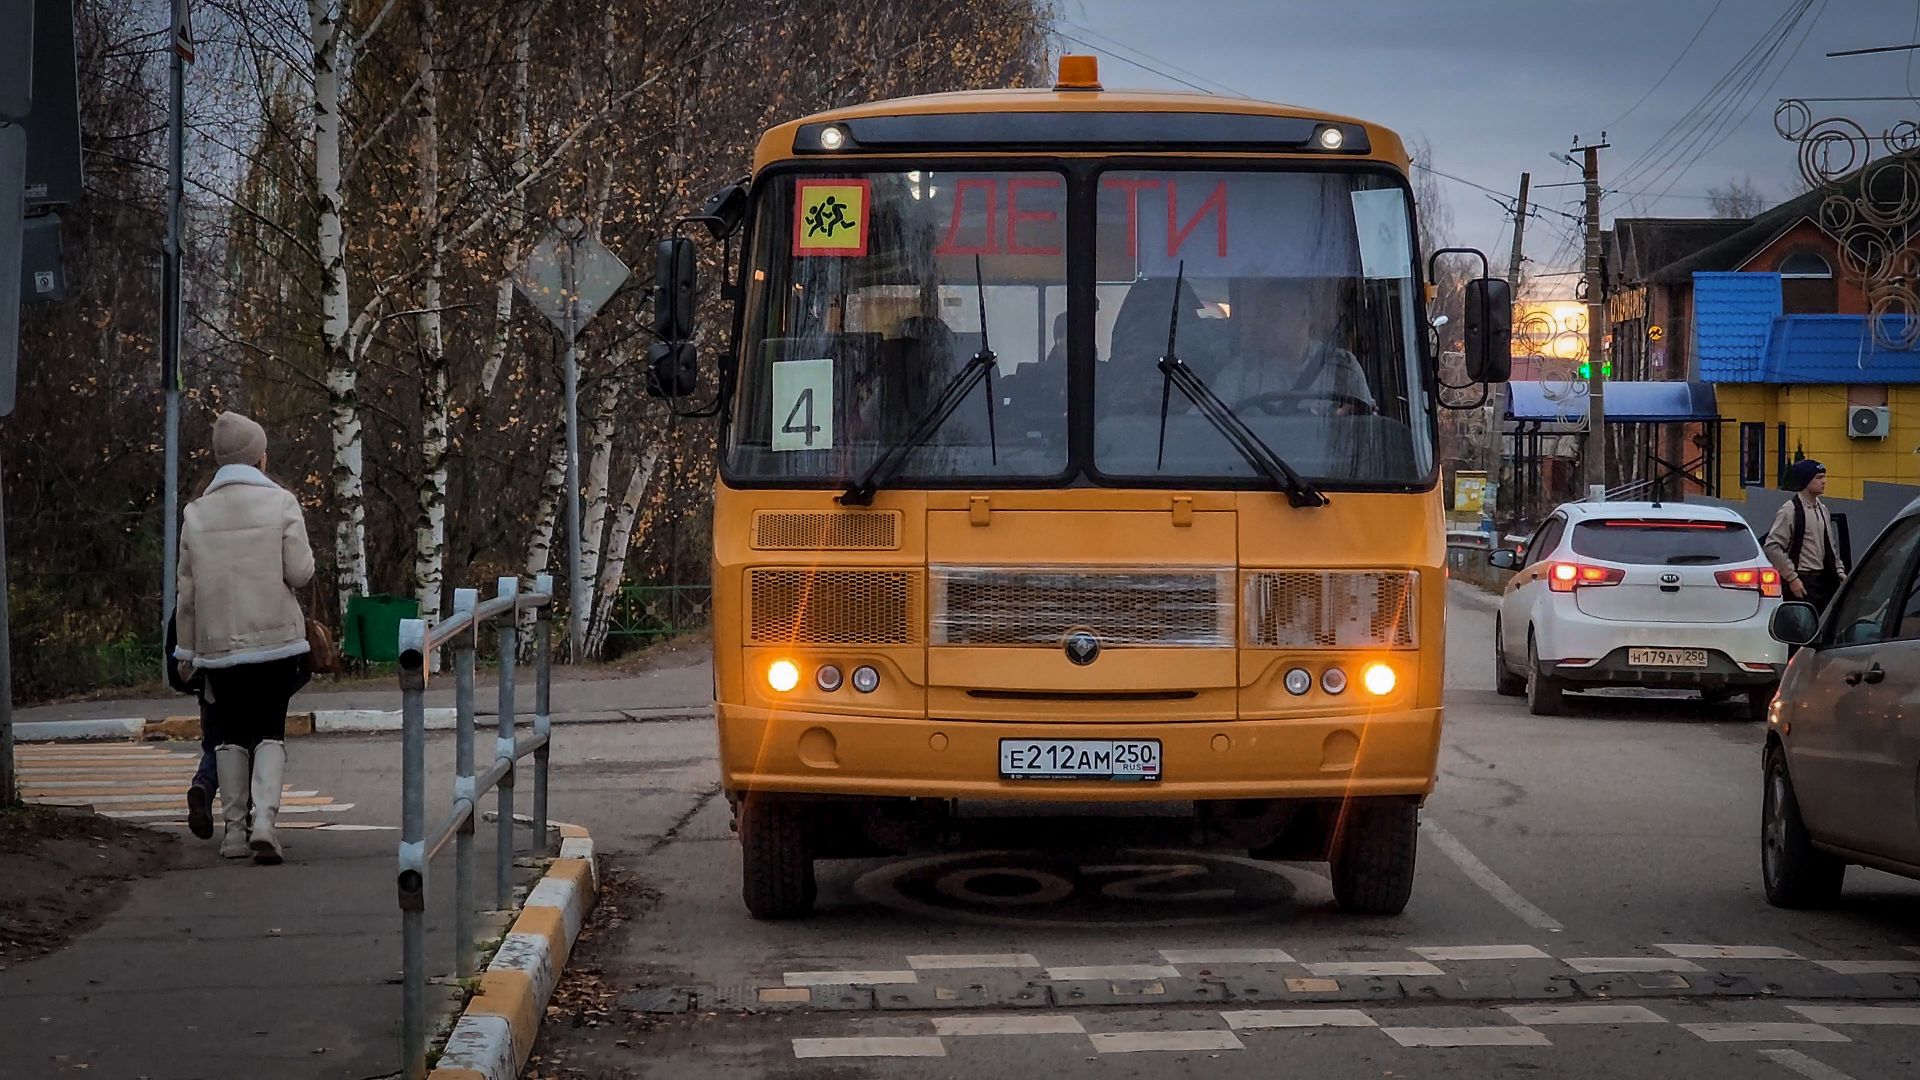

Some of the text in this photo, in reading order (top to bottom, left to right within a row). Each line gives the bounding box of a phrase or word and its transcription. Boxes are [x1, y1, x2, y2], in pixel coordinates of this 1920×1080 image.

[782, 388, 821, 447] 4
[1685, 651, 1706, 662] 250
[1010, 744, 1153, 770] Е212АМ 250
